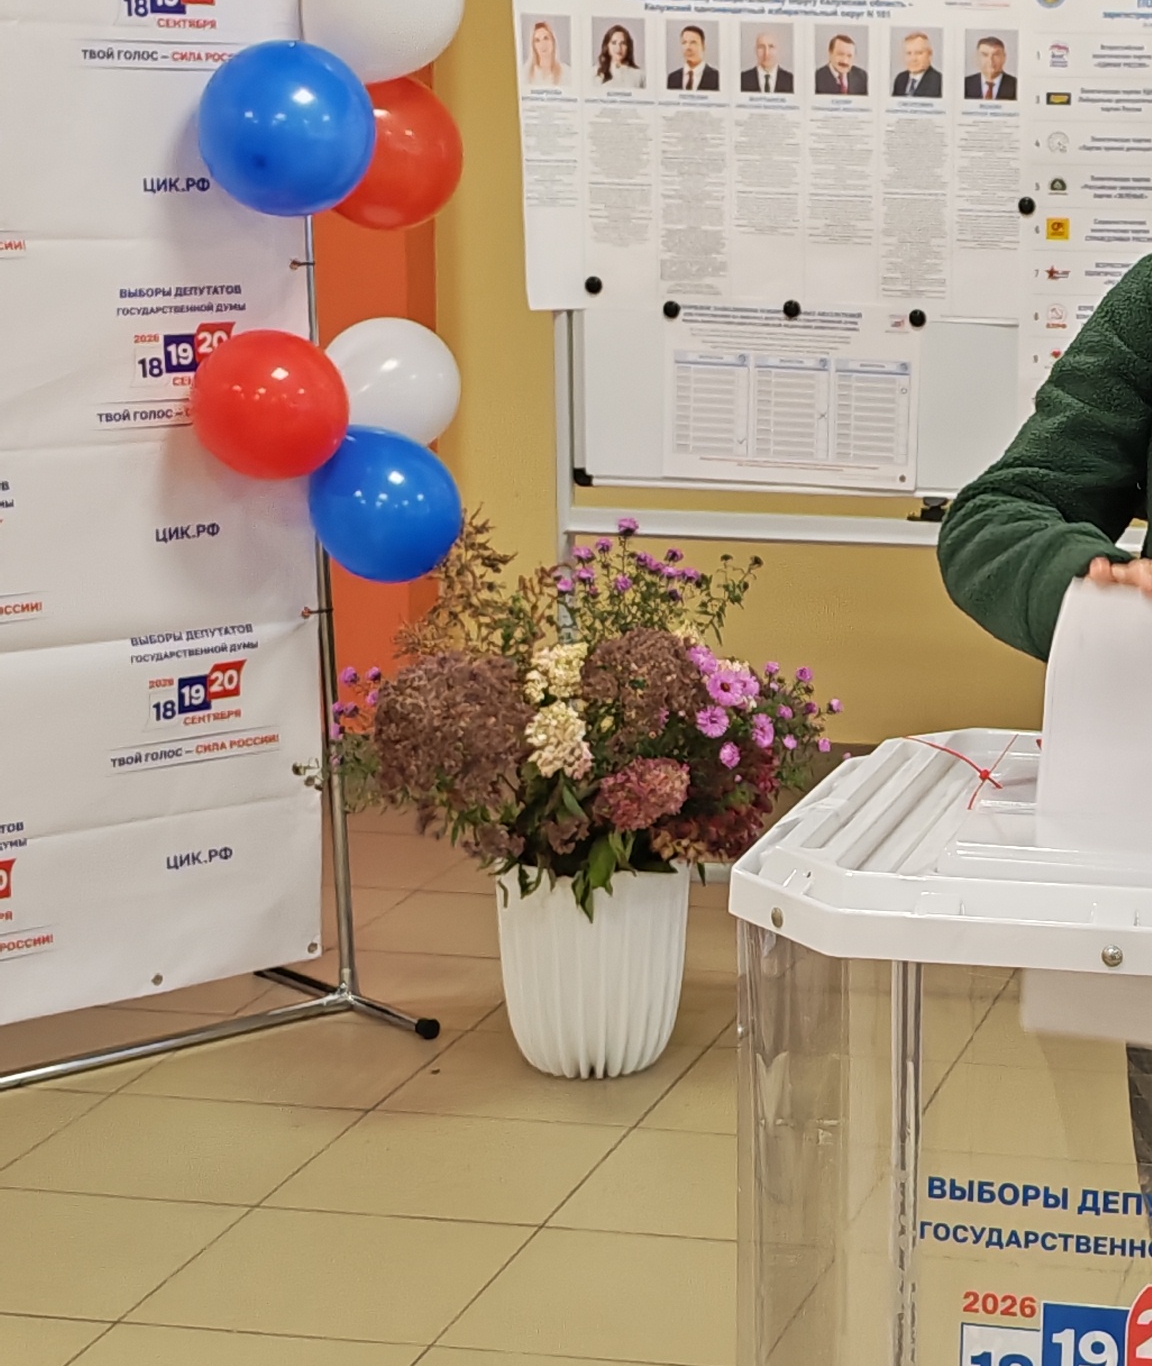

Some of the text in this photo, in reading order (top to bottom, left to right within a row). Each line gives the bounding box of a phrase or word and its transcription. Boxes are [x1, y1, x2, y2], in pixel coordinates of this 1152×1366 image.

[157, 17, 218, 30] СЕНТЯБРЯ
[81, 47, 115, 60] ТВОЙ
[117, 48, 159, 61] ГОЛОС
[171, 50, 203, 62] СИЛА
[143, 177, 211, 196] ЦИК.РФ
[119, 285, 242, 299] ВЫБОРЫ ДЕПУТАТОВ
[116, 302, 247, 317] ГОСУДАРСТВЕННОЙ ДУМЫ
[197, 330, 229, 355] 20
[166, 343, 194, 366] 19
[138, 356, 164, 378] 18
[97, 409, 131, 424] ТВОЙ
[133, 408, 174, 422] ГОЛОС
[155, 522, 221, 543] ЦИК.РФ
[130, 623, 254, 647] ВЫБОРЫ ДЕПУТАТОВ
[130, 642, 229, 665] ГОСУДАРСТВЕННОЙ
[209, 668, 239, 692] 20
[180, 683, 207, 707] 19
[152, 700, 177, 722] 18
[183, 708, 242, 727] СЕНТЯБРЯ
[110, 751, 143, 769] ТВОЙ
[144, 746, 183, 763] ГОЛОС
[195, 740, 227, 755] СИЛА
[229, 734, 280, 750] РОССИИ!
[166, 846, 233, 870] ЦИК.РФ
[927, 1176, 1069, 1211] ВЫБОРЫ
[961, 1290, 1037, 1318] 2026
